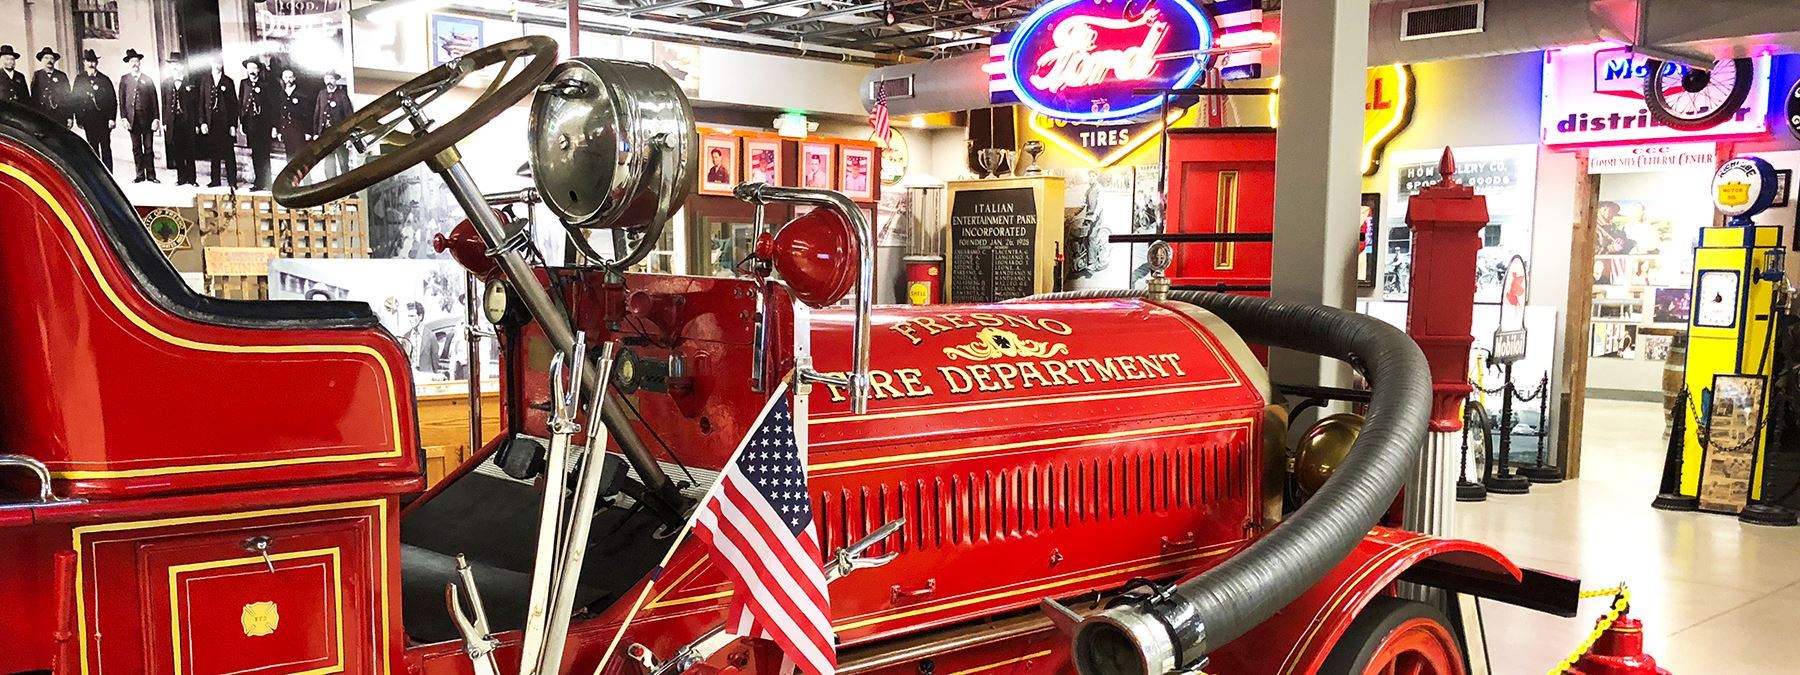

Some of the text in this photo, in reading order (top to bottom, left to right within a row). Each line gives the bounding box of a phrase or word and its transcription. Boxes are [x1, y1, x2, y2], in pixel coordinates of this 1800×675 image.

[1029, 9, 1168, 93] Ford
[1079, 128, 1130, 148] TIRES
[1678, 153, 1713, 166] CENTER
[1468, 175, 1510, 186] GOODS
[974, 203, 1014, 214] ITALIAN
[952, 214, 1037, 226] ENTERTAINMENT PARK
[961, 226, 1027, 237] INCORPORATED
[959, 238, 988, 246] FOUNDED
[890, 313, 1073, 345] FRESNO
[938, 353, 1187, 394] DEPARTMENT
